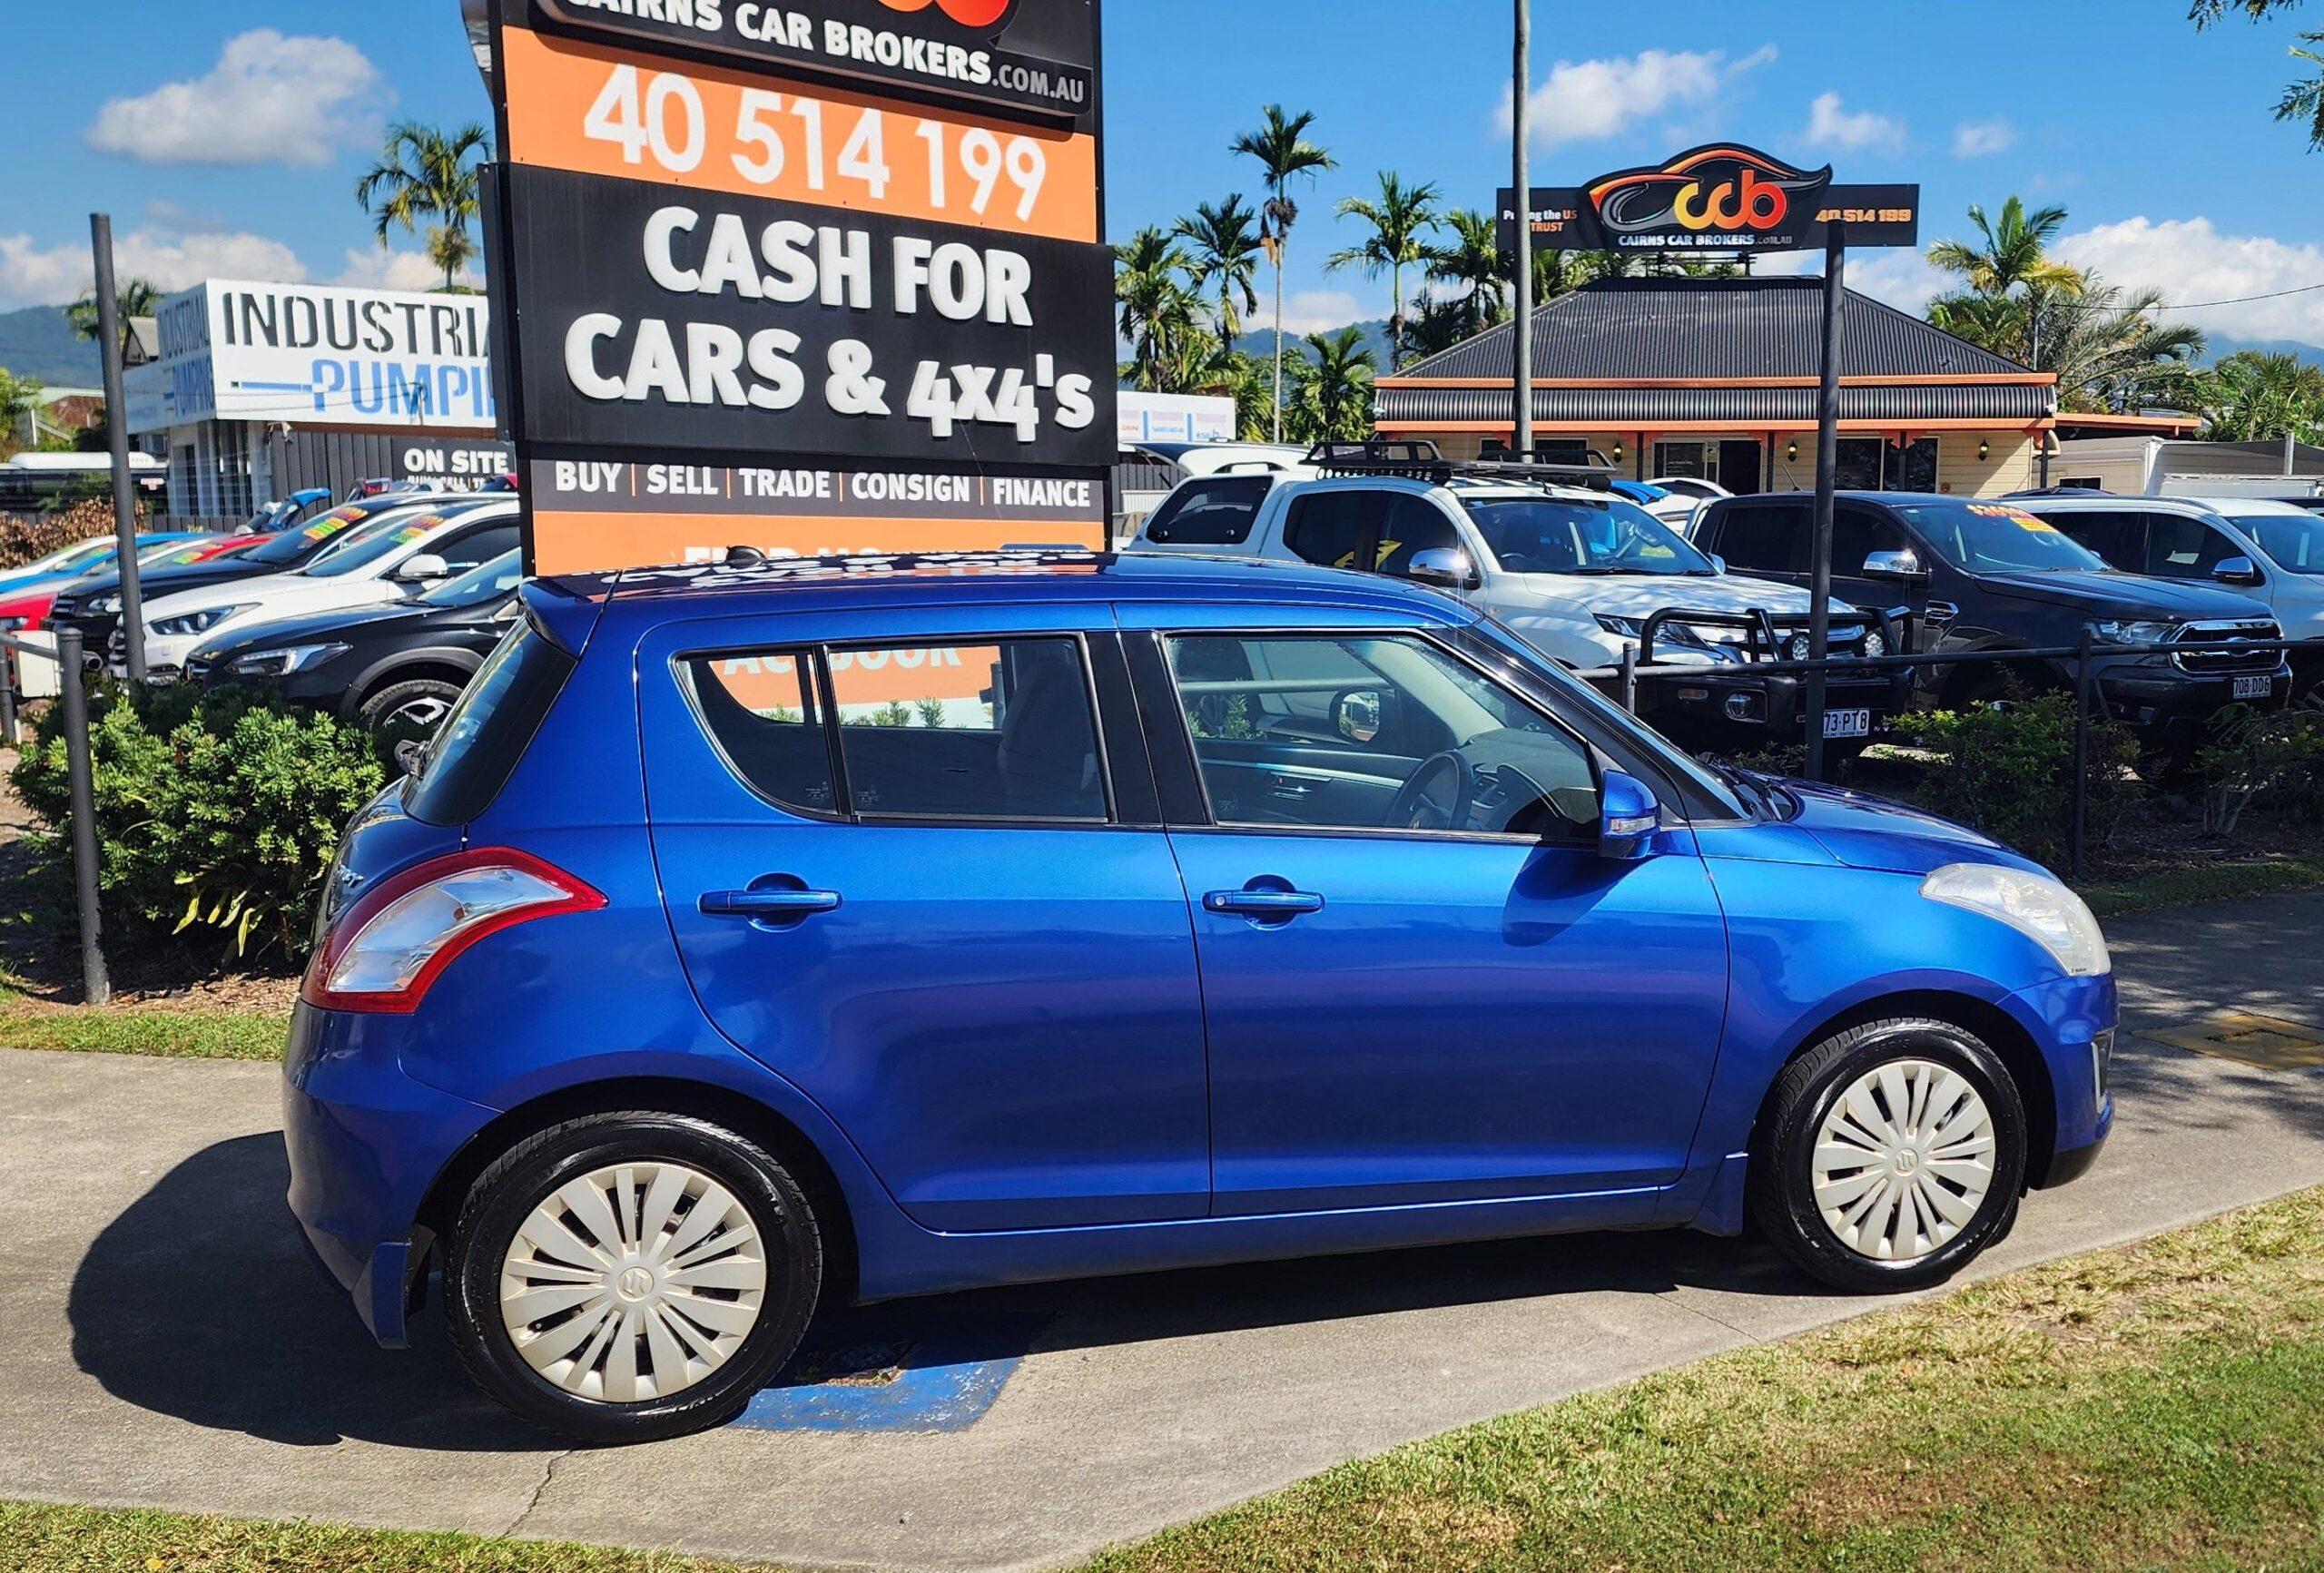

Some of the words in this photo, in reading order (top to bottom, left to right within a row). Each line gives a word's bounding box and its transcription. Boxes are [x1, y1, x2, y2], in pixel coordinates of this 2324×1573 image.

[567, 0, 723, 31] RNS
[735, 3, 814, 51] CAR
[583, 64, 706, 173] 40
[732, 89, 890, 201] 514
[917, 120, 1047, 222] 199
[1531, 221, 1564, 232] TRUST
[1542, 209, 1561, 221] the
[1562, 210, 1578, 220] US
[1843, 209, 1876, 222] 514
[1878, 209, 1911, 222] 199
[1618, 234, 1665, 246] CAIRNS
[1667, 234, 1692, 246] CAR
[643, 206, 872, 310] CASH
[892, 236, 1033, 327] FOR
[222, 292, 489, 357] INDUSTRI
[311, 359, 495, 418] PUMPI
[565, 312, 805, 410] CARS
[825, 339, 891, 416] &
[404, 447, 445, 472] ON
[450, 449, 508, 475] SITE
[555, 461, 624, 495] BUY
[646, 464, 719, 496] SELL
[738, 467, 831, 499] TRADE
[852, 471, 970, 504] CONSIGN
[993, 478, 1091, 508] FINANCE
